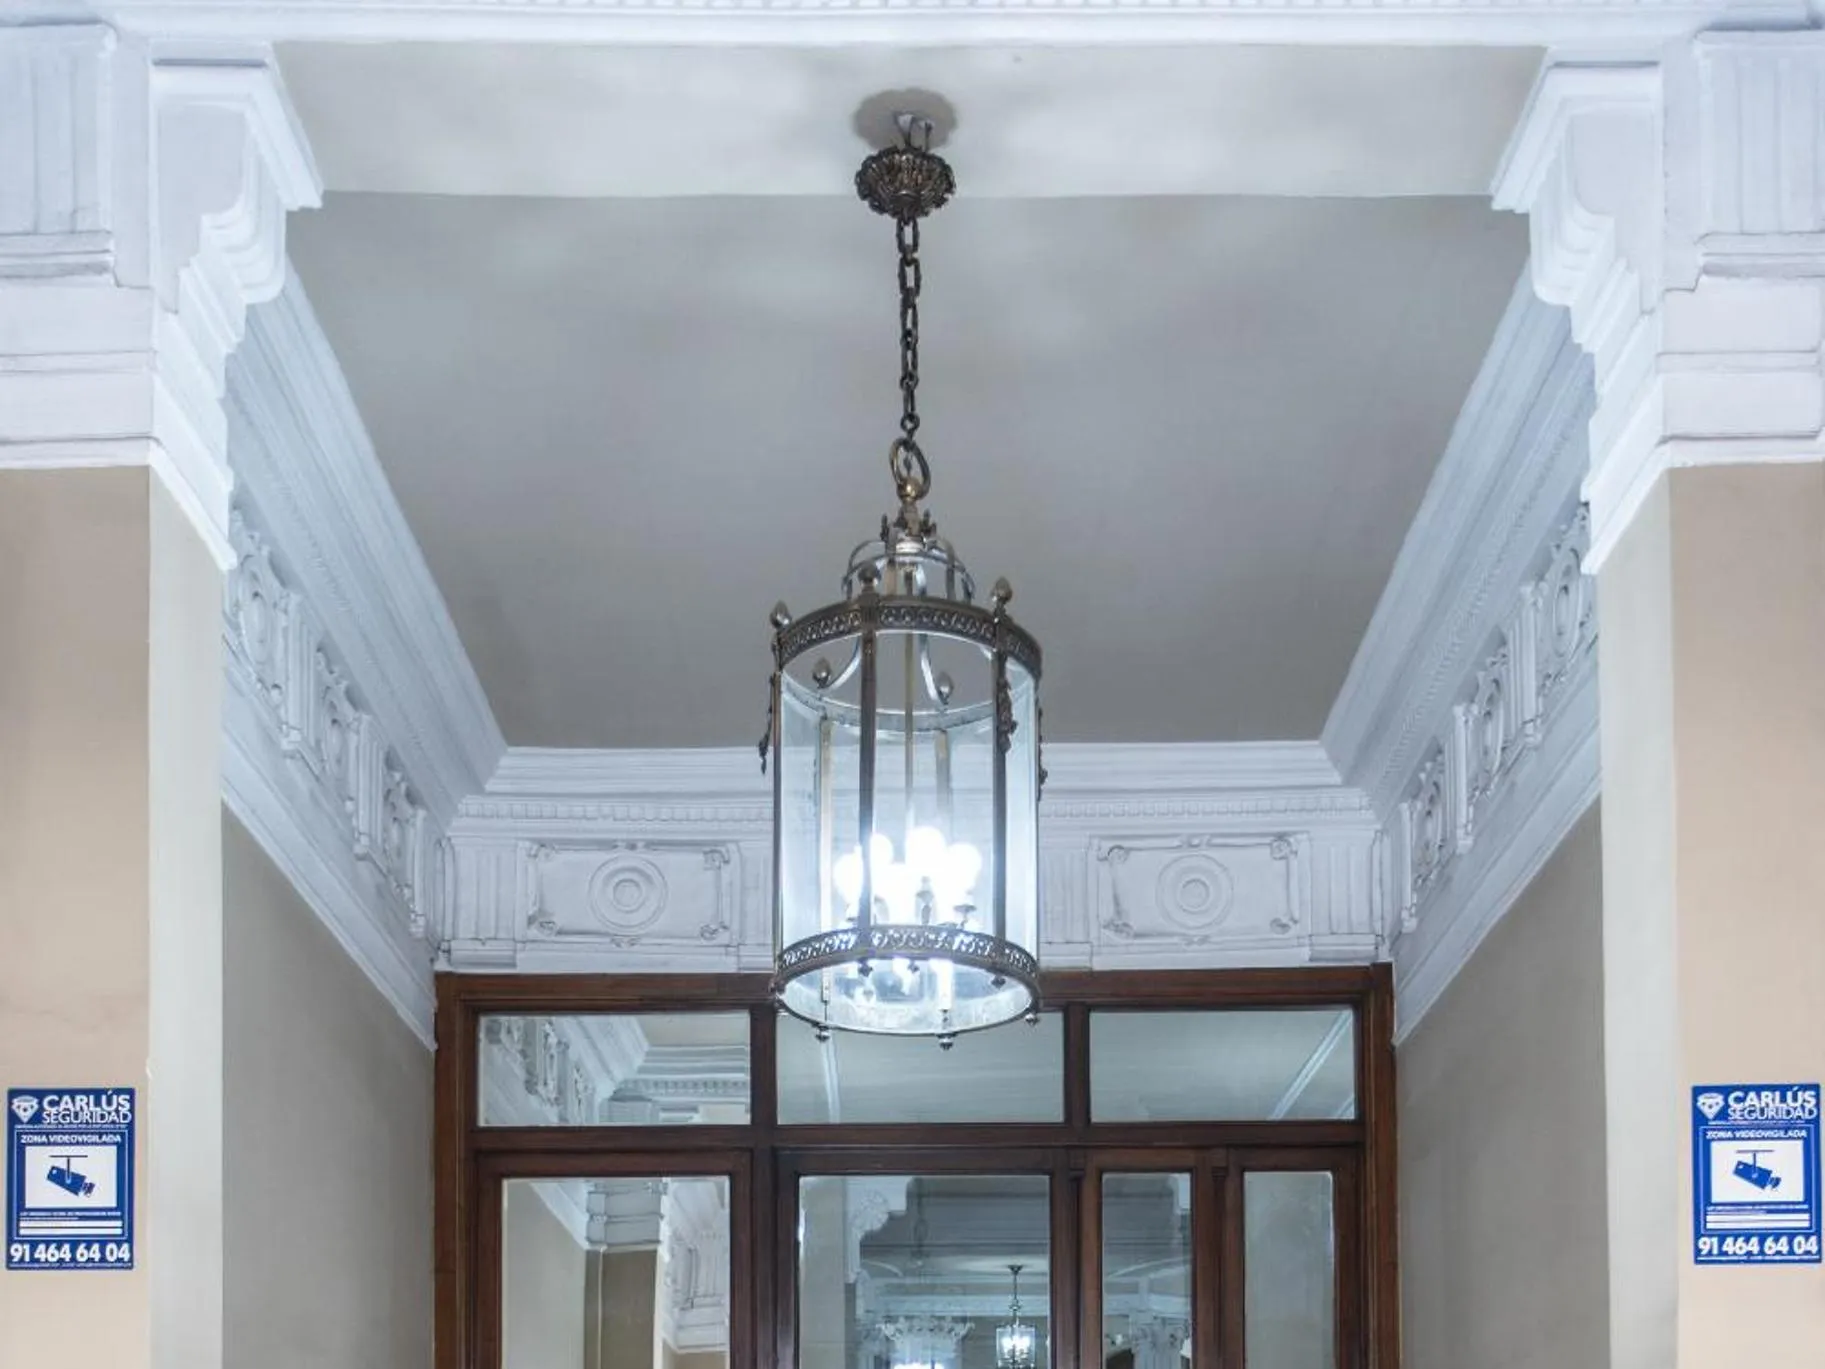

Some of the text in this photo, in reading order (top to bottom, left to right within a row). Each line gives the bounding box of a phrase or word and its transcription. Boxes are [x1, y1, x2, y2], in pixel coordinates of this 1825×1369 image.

[42, 1089, 131, 1111] CARLÚS
[1728, 1086, 1816, 1107] CARLÚS
[42, 1110, 132, 1124] SEGURIDAD
[1728, 1107, 1818, 1120] SEGURIDAD
[20, 1134, 122, 1144] ZONA VIDEOVIGILADA
[1706, 1129, 1807, 1139] ZONA VIDEOVIGILADA
[10, 1243, 130, 1262] 91 464 64 04
[1698, 1235, 1818, 1255] 91 464 64 04
